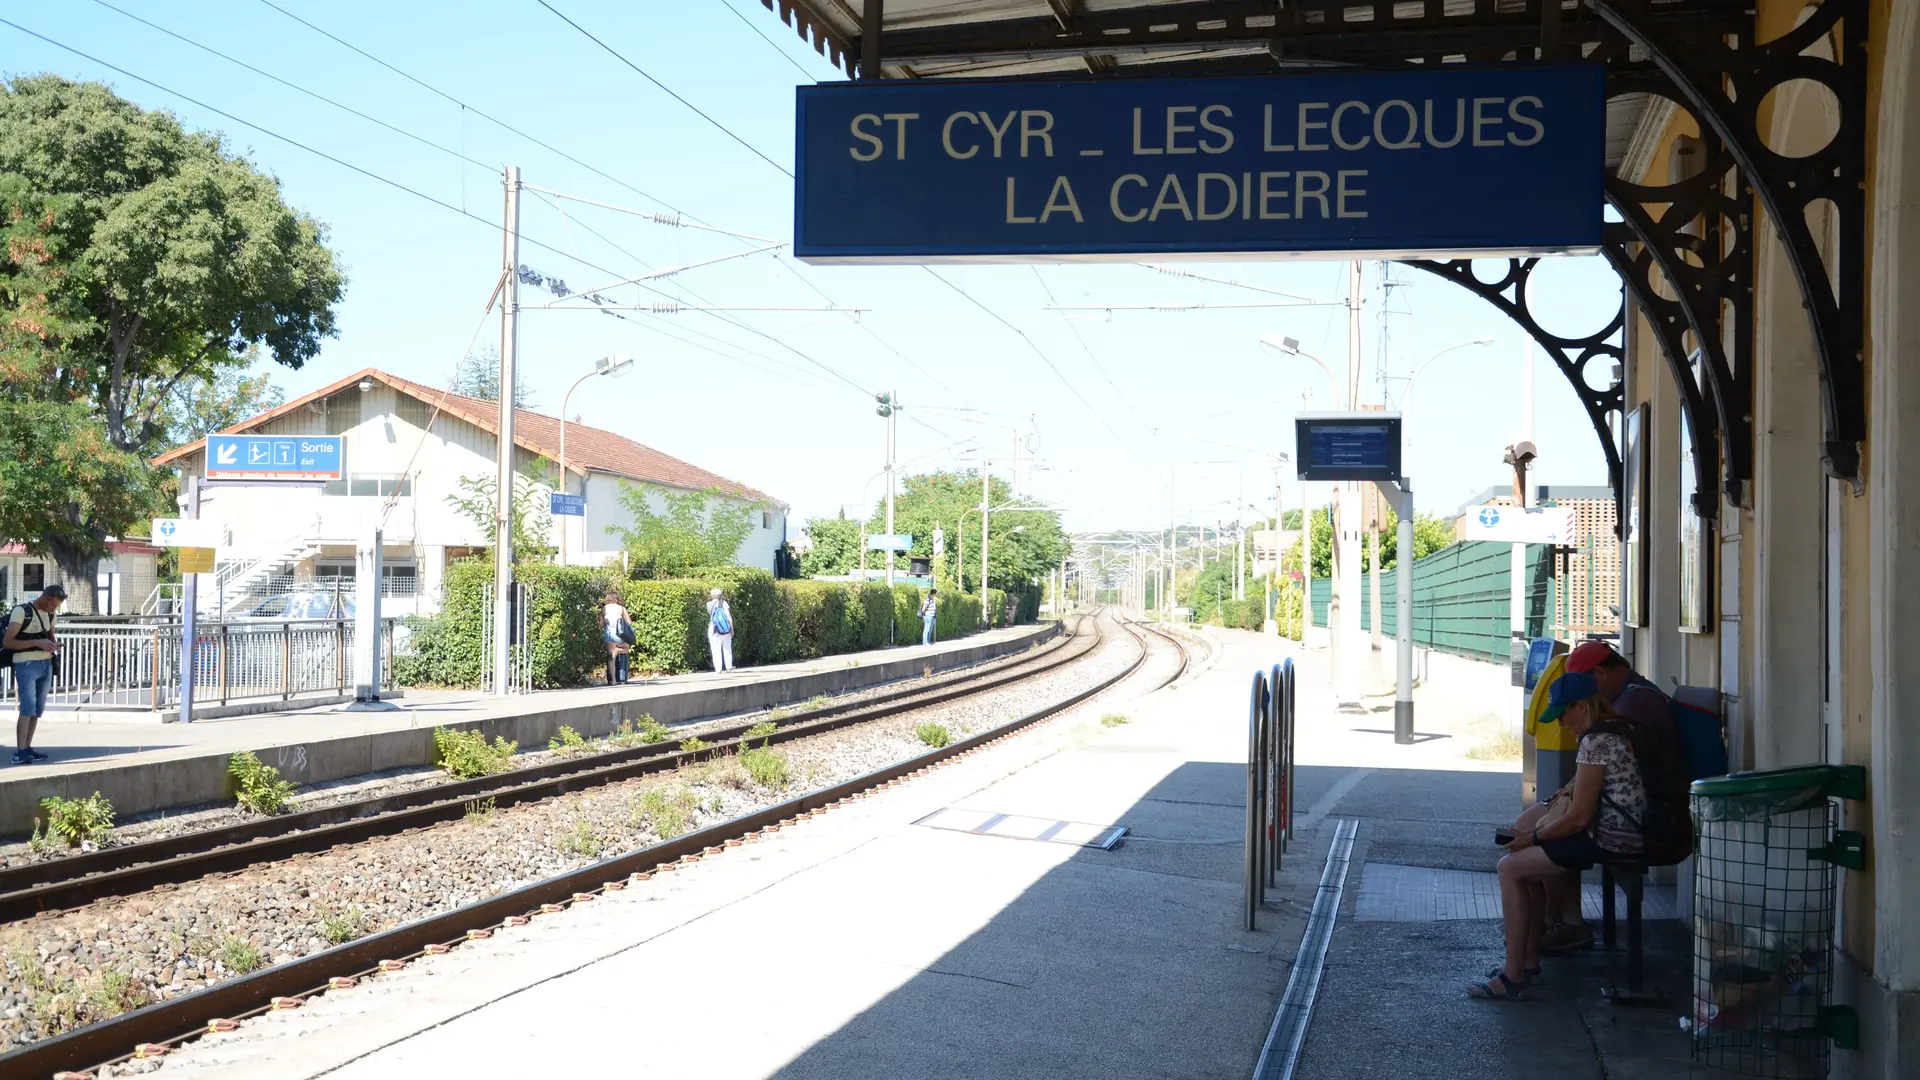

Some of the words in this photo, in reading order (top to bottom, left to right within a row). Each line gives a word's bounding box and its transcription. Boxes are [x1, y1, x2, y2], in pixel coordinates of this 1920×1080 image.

[850, 112, 920, 161] ST
[942, 110, 1054, 160] CYR
[1132, 105, 1234, 156] LES
[1263, 94, 1546, 152] LECQUES
[1006, 175, 1084, 224] LA
[1110, 169, 1369, 223] CADIERE
[281, 451, 288, 462] 1
[301, 441, 334, 453] Sortie
